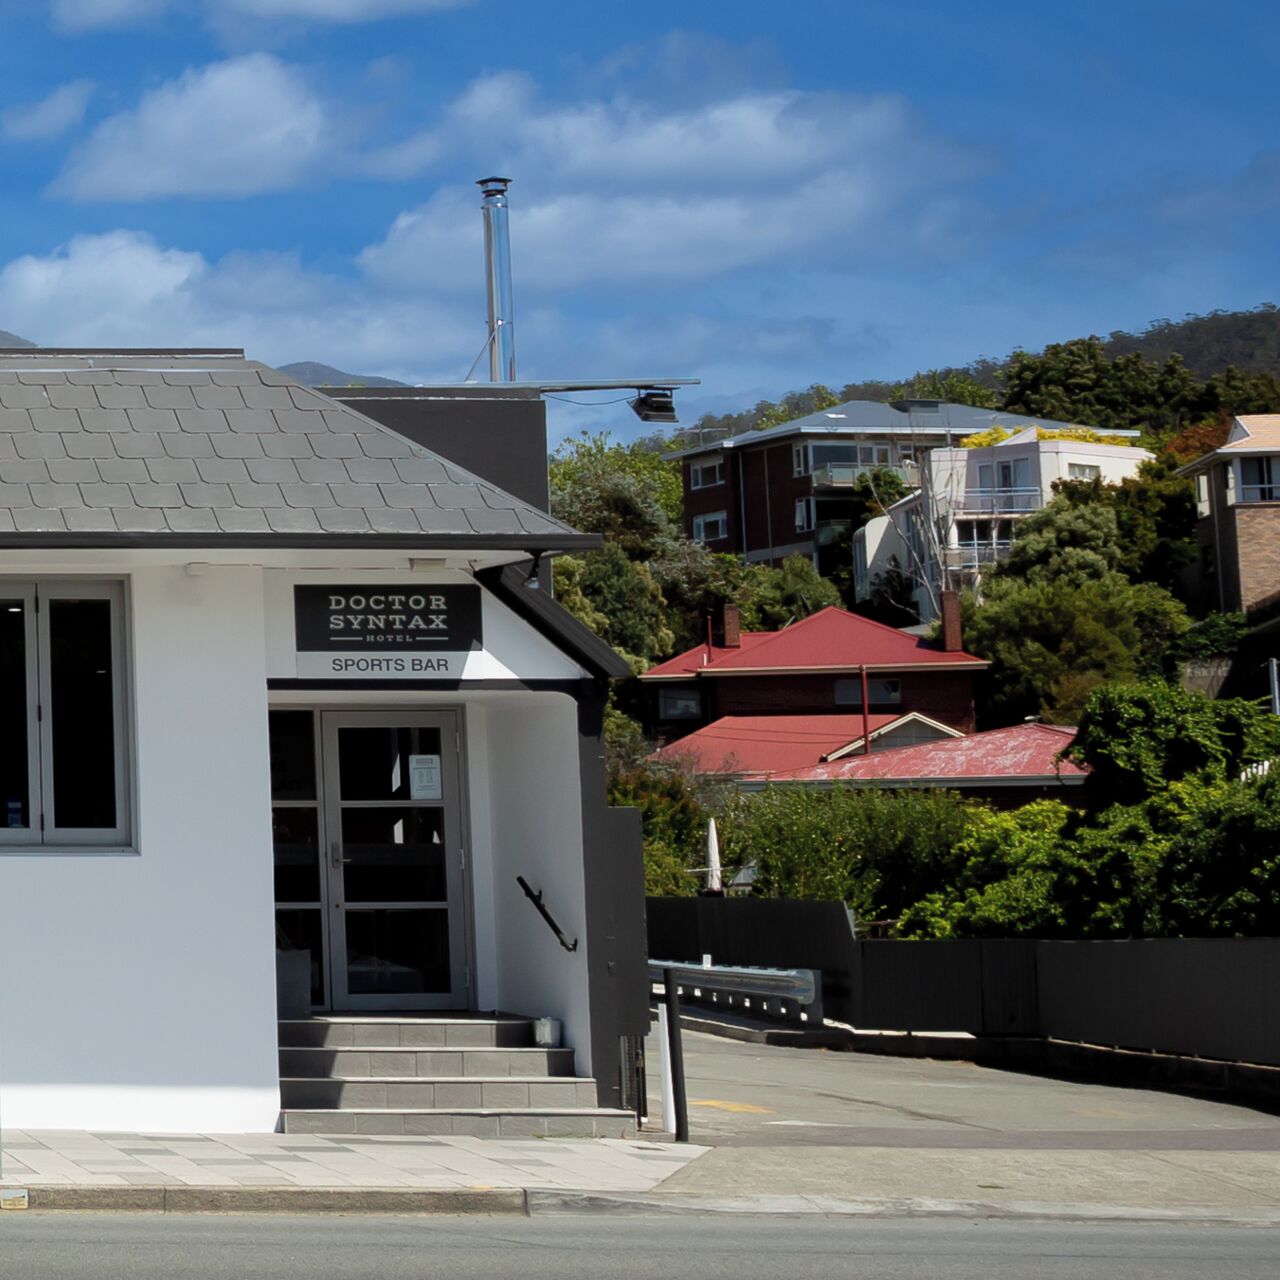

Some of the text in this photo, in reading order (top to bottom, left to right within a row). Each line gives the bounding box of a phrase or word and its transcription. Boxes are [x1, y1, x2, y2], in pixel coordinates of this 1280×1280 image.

[328, 595, 447, 610] DOCTOR
[328, 615, 448, 629] SYNTAX
[332, 658, 449, 672] SPORTS BAR
